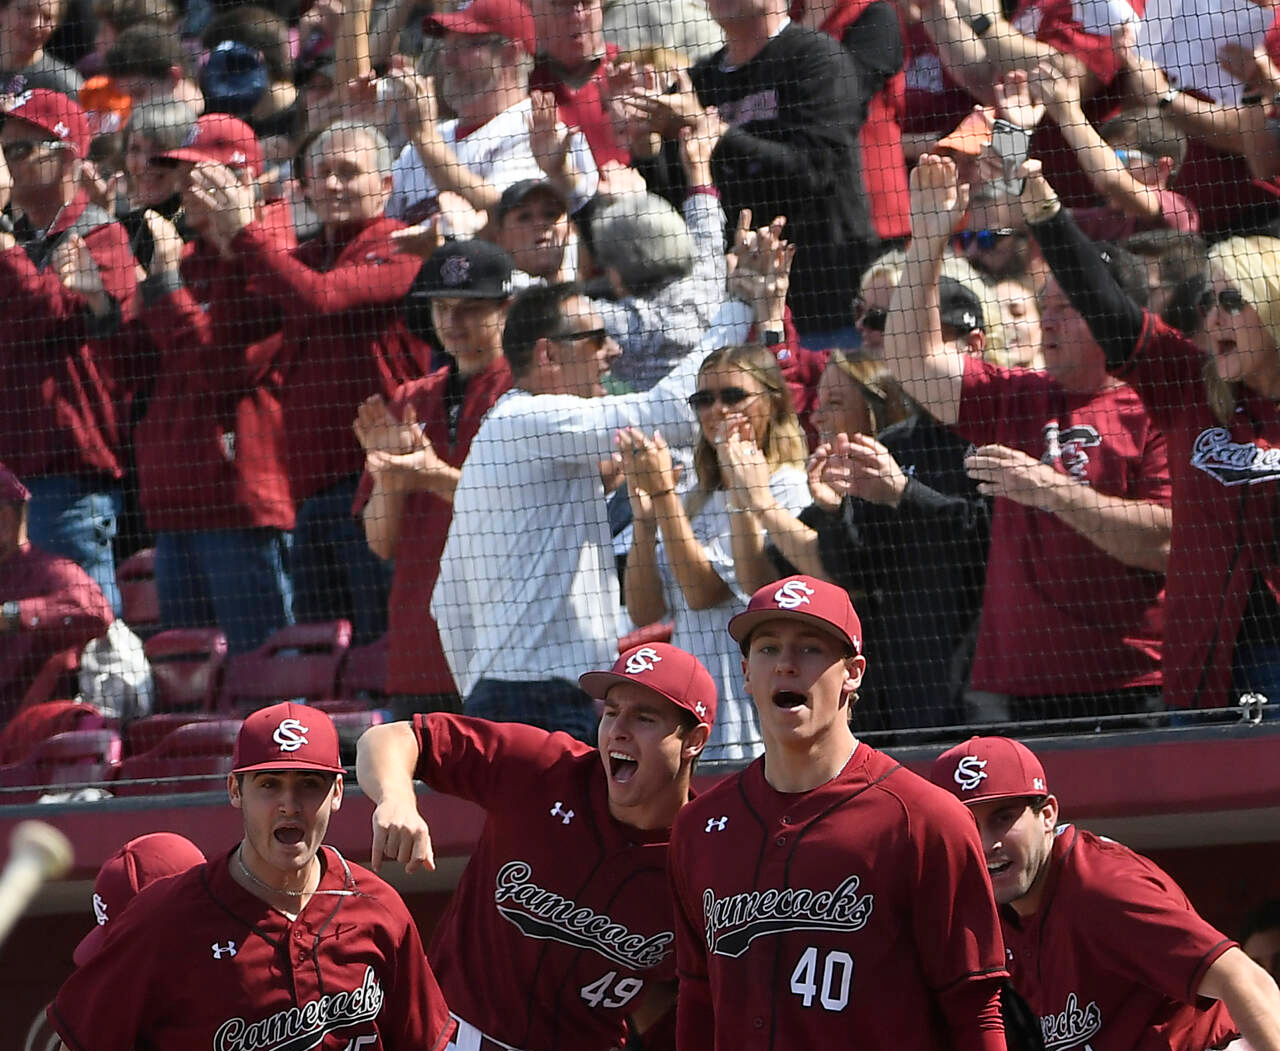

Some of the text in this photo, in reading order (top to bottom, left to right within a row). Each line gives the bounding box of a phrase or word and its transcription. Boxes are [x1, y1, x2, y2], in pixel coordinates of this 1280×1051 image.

[774, 580, 814, 609] SC
[625, 647, 662, 674] SC
[273, 719, 309, 752] SC
[954, 755, 988, 791] SC
[703, 875, 873, 953] Gamecocks
[580, 971, 644, 1008] 49
[790, 946, 854, 1012] 40
